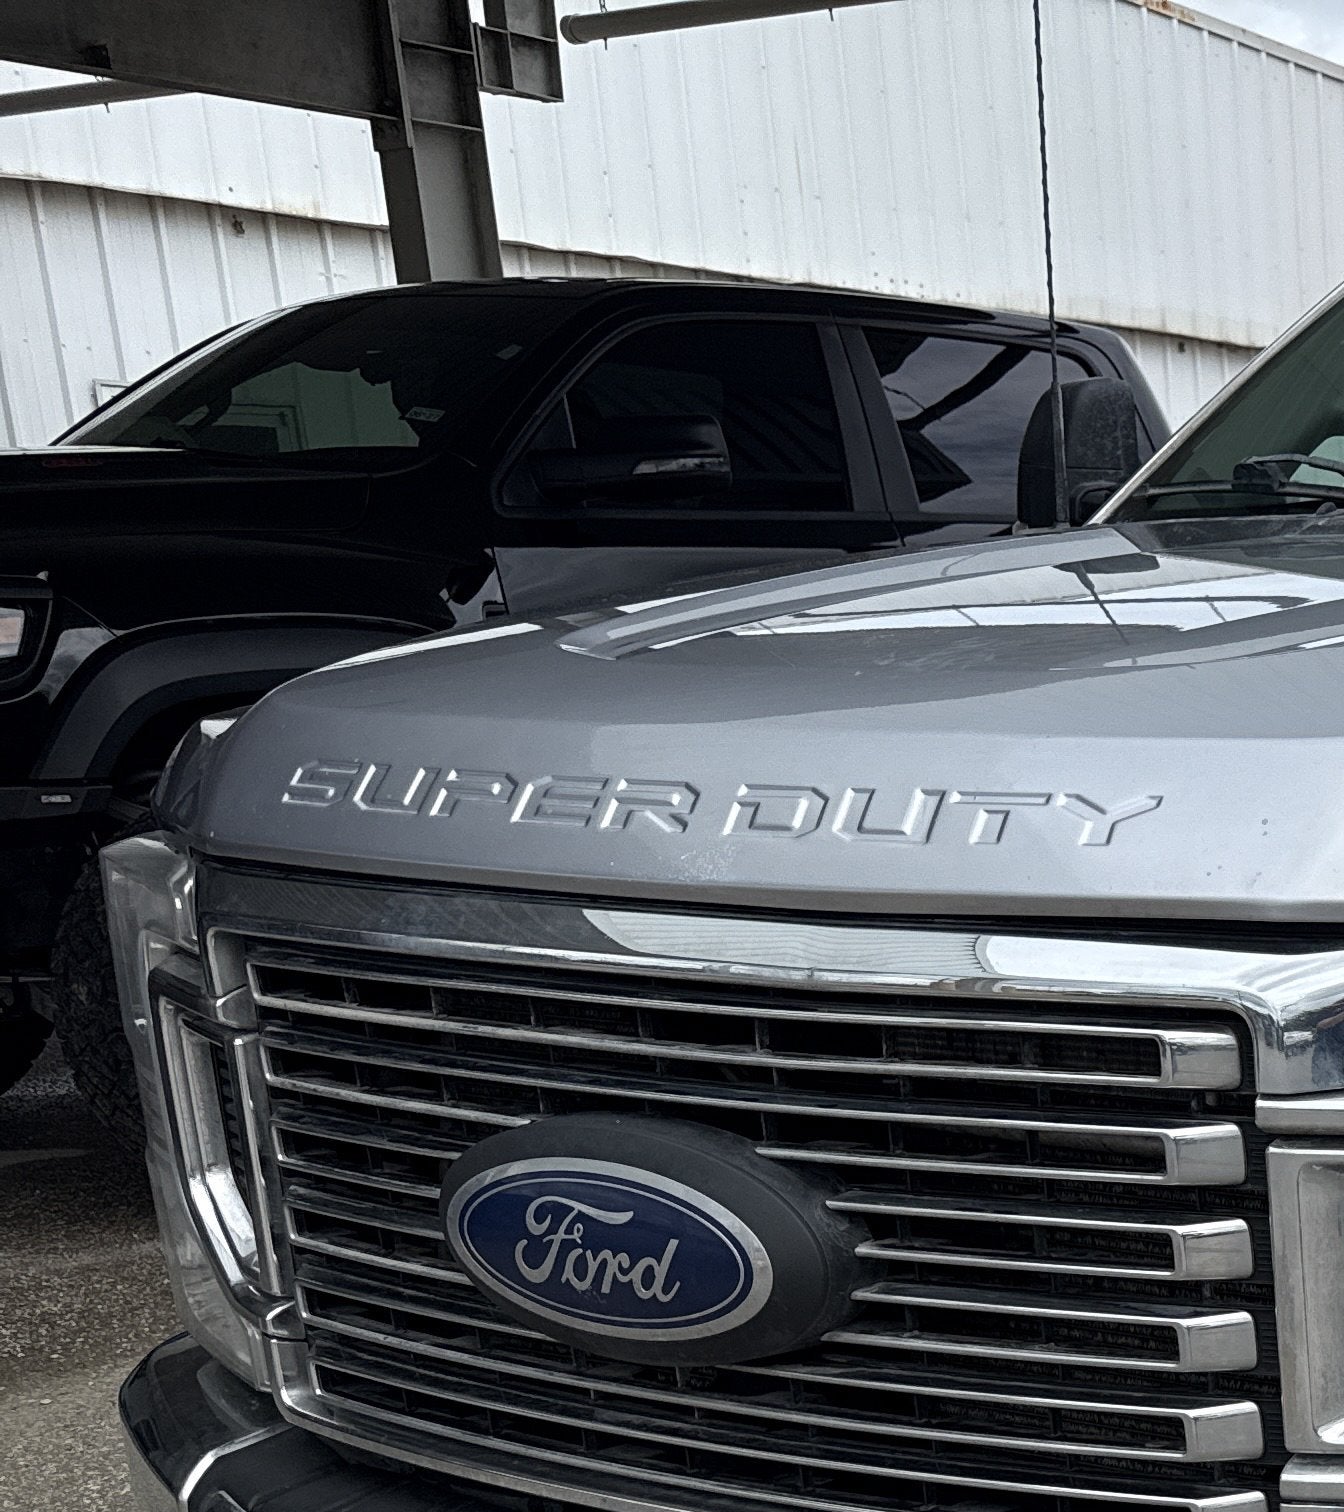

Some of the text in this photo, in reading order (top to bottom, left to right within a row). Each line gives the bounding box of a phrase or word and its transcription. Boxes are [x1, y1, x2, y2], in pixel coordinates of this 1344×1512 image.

[281, 758, 1164, 846] SUPER DUTY
[514, 1195, 682, 1303] Ford
